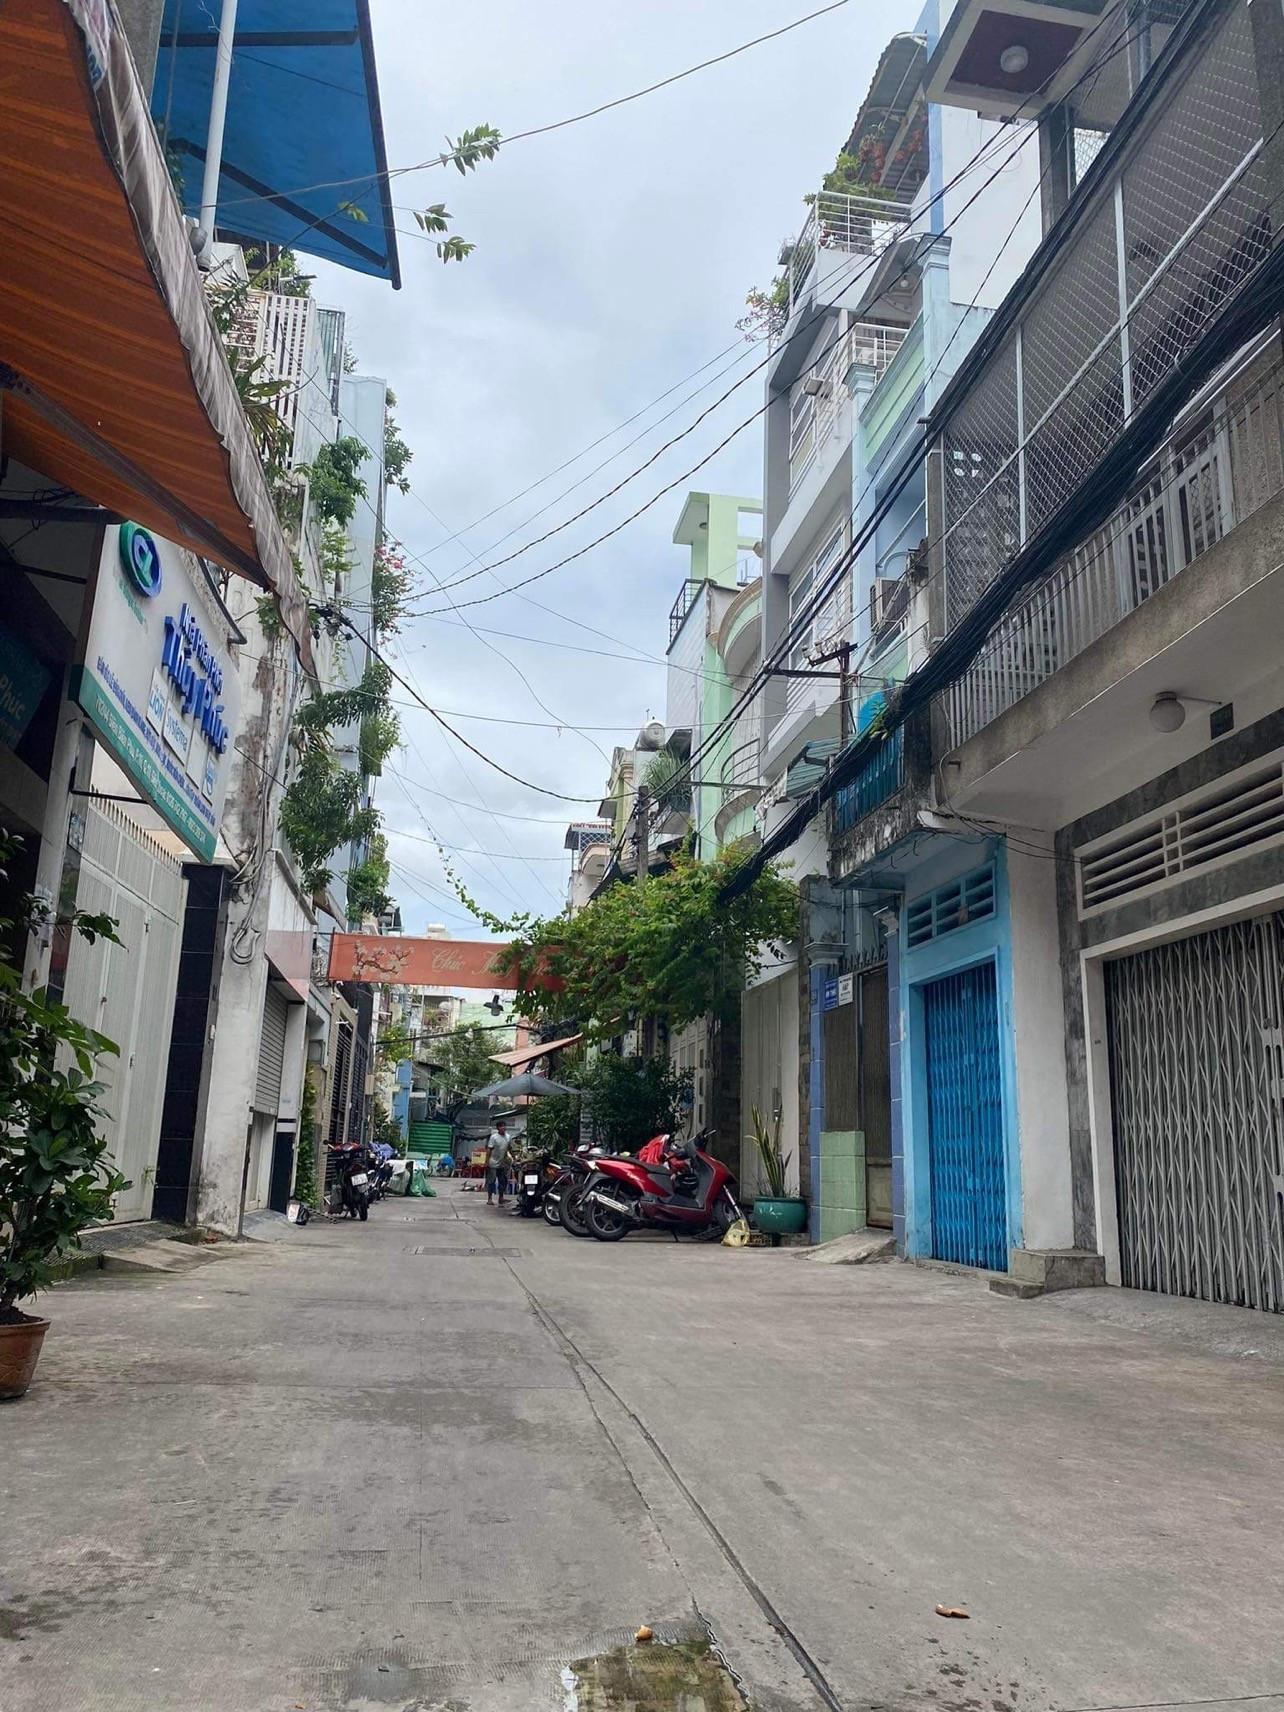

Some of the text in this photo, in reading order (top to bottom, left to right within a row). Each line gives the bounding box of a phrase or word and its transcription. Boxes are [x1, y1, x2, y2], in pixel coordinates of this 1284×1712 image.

[149, 690, 165, 722] LION
[195, 679, 228, 755] Phúc
[166, 708, 188, 752] Systema
[431, 947, 465, 973] Chúc
